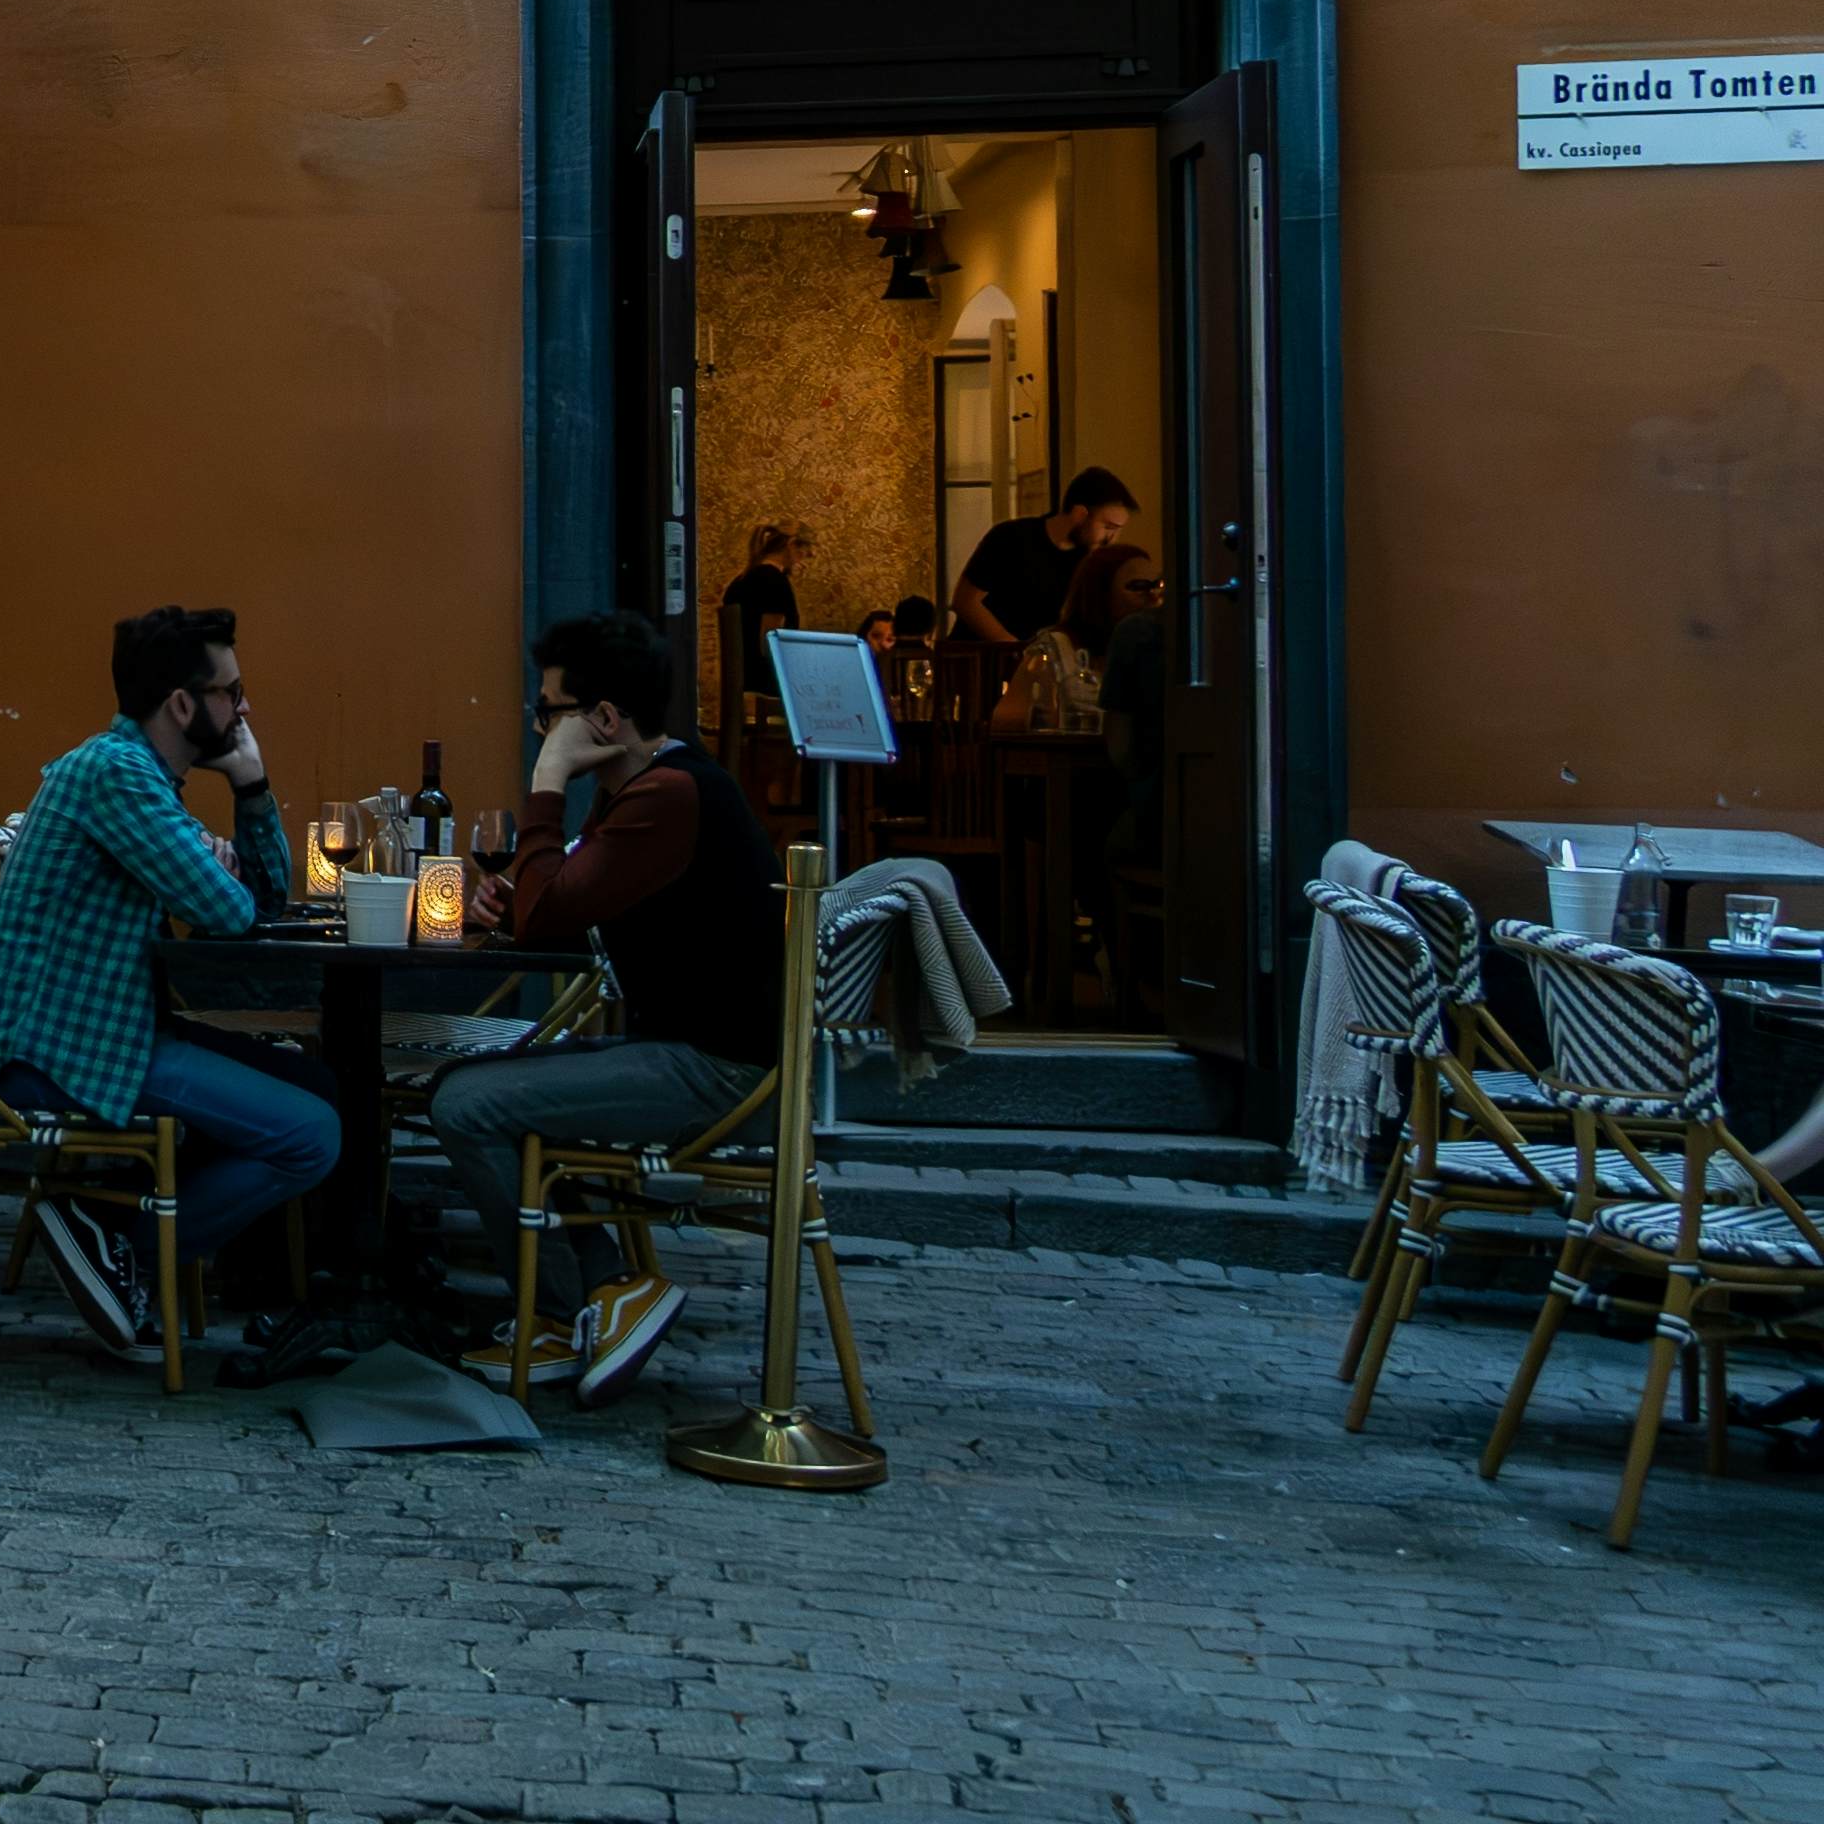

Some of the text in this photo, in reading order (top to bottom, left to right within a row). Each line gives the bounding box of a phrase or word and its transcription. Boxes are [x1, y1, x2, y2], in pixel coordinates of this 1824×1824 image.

[1553, 69, 1817, 104] Brända Tomten
[1526, 141, 1642, 160] kv. Cassiopea
